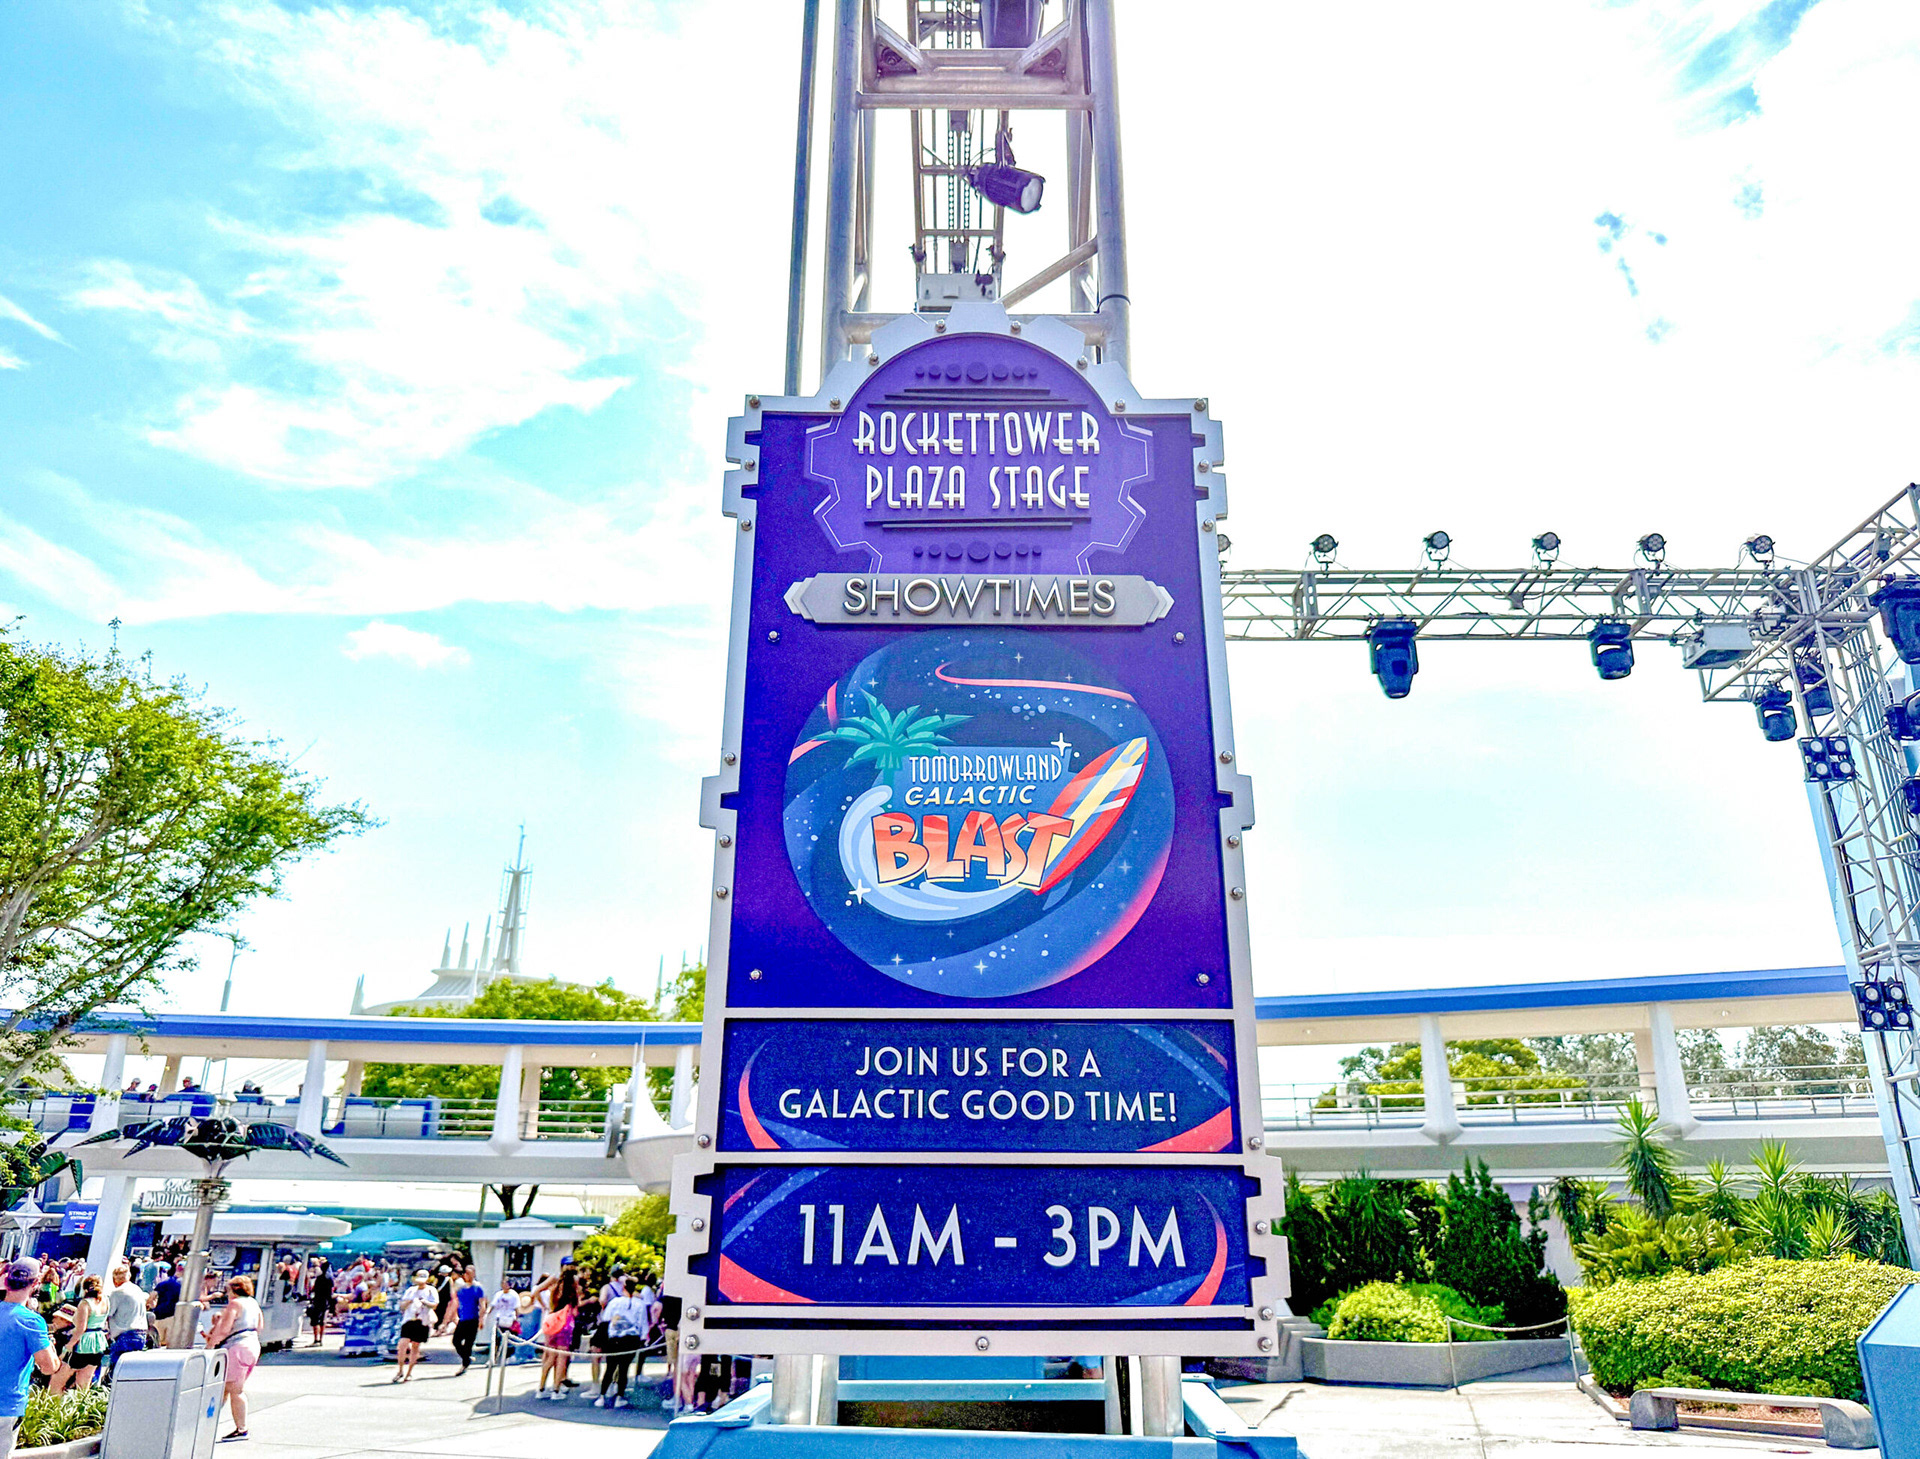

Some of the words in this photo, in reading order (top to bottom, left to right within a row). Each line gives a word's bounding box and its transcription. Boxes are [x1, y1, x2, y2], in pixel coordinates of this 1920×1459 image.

[852, 410, 1100, 455] ROCKETTOWER
[866, 464, 966, 509] PLAZA
[989, 464, 1090, 509] STAGE
[844, 576, 1116, 618] SHOWTIMES
[909, 754, 1062, 783] TOMORROWLAND
[905, 785, 1036, 806] GALACTIC
[871, 810, 1074, 890] BLAST
[855, 1046, 938, 1076] JOIN
[952, 1047, 988, 1077] US
[1002, 1048, 1069, 1077] FOR
[1079, 1048, 1102, 1078] A
[779, 1088, 950, 1119] GALACTIC
[961, 1090, 1075, 1121] GOOD
[1085, 1092, 1178, 1122] TIME!
[800, 1203, 965, 1266] 11AM
[994, 1237, 1017, 1248] -
[1043, 1205, 1186, 1267] 3PM
